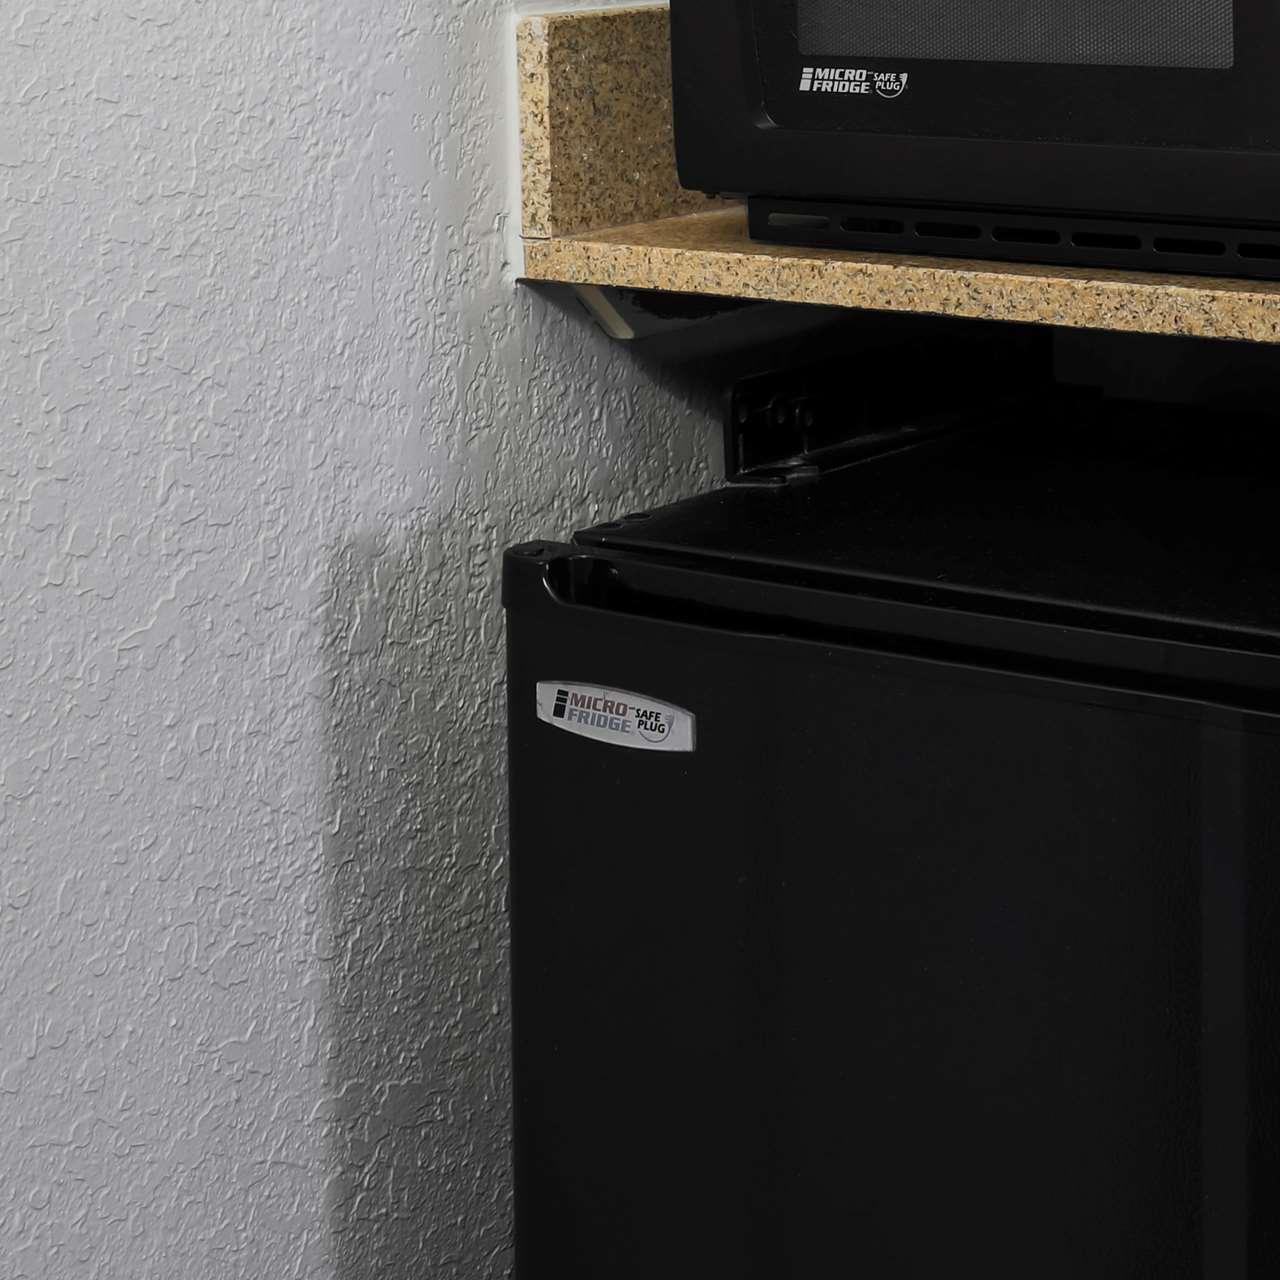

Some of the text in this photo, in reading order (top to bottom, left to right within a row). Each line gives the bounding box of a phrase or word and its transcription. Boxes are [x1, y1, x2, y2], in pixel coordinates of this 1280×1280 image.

[814, 68, 866, 80] MICRO
[873, 72, 896, 82] SAFE
[813, 80, 870, 93] FRIDGE
[875, 82, 900, 91] PLUG
[570, 693, 629, 717] MICRO
[567, 710, 631, 733] FRIDGE
[635, 708, 662, 722] SAFE
[637, 720, 666, 734] PLUG
